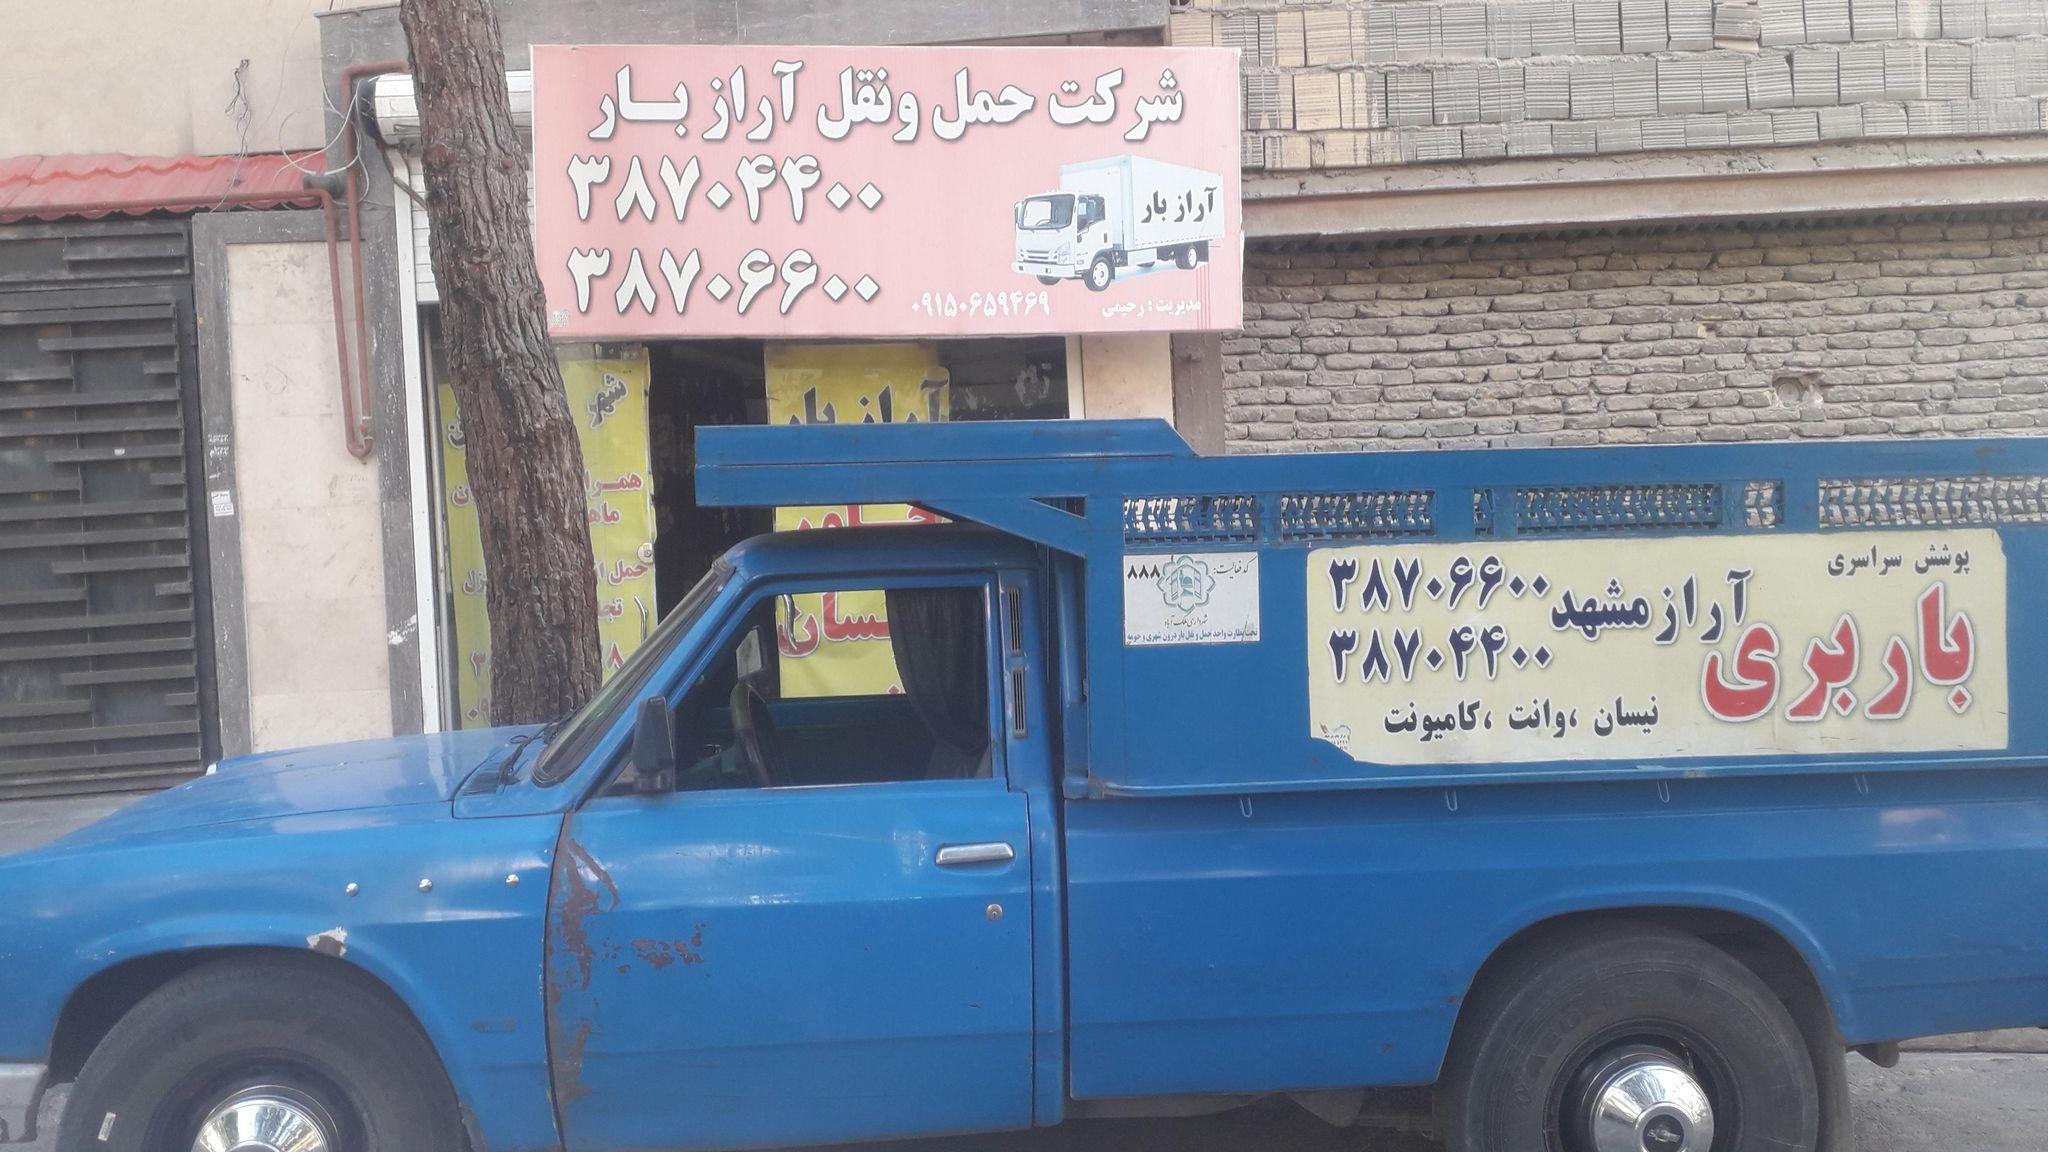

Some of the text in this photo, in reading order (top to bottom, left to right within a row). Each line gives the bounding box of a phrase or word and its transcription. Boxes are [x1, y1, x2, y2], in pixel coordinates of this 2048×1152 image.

[588, 64, 689, 140] بار
[702, 59, 804, 140] آراز
[932, 66, 1036, 140] حمل
[1049, 67, 1184, 141] شرکت
[567, 154, 883, 222] ۳۸۷۰۴۴۰۰
[1140, 186, 1217, 223] آراز بار
[567, 247, 880, 315] ۳۸۷۰۶۶۰۰
[911, 291, 1050, 317] ۰۹۱۵۰۶۵۹۴۶۹
[1102, 301, 1145, 318] رحیمی
[1155, 299, 1201, 316] مدیریت
[1127, 564, 1160, 579] ۸۸۸
[1328, 555, 1550, 612] ۳۸۷۰۶۶۰۰
[1828, 544, 1970, 575] پوشش سراسری
[1551, 577, 1650, 641] مشهد
[1328, 625, 1553, 682] ۳۸۷۰۴۴۰۰
[1594, 696, 1659, 736] نیسان
